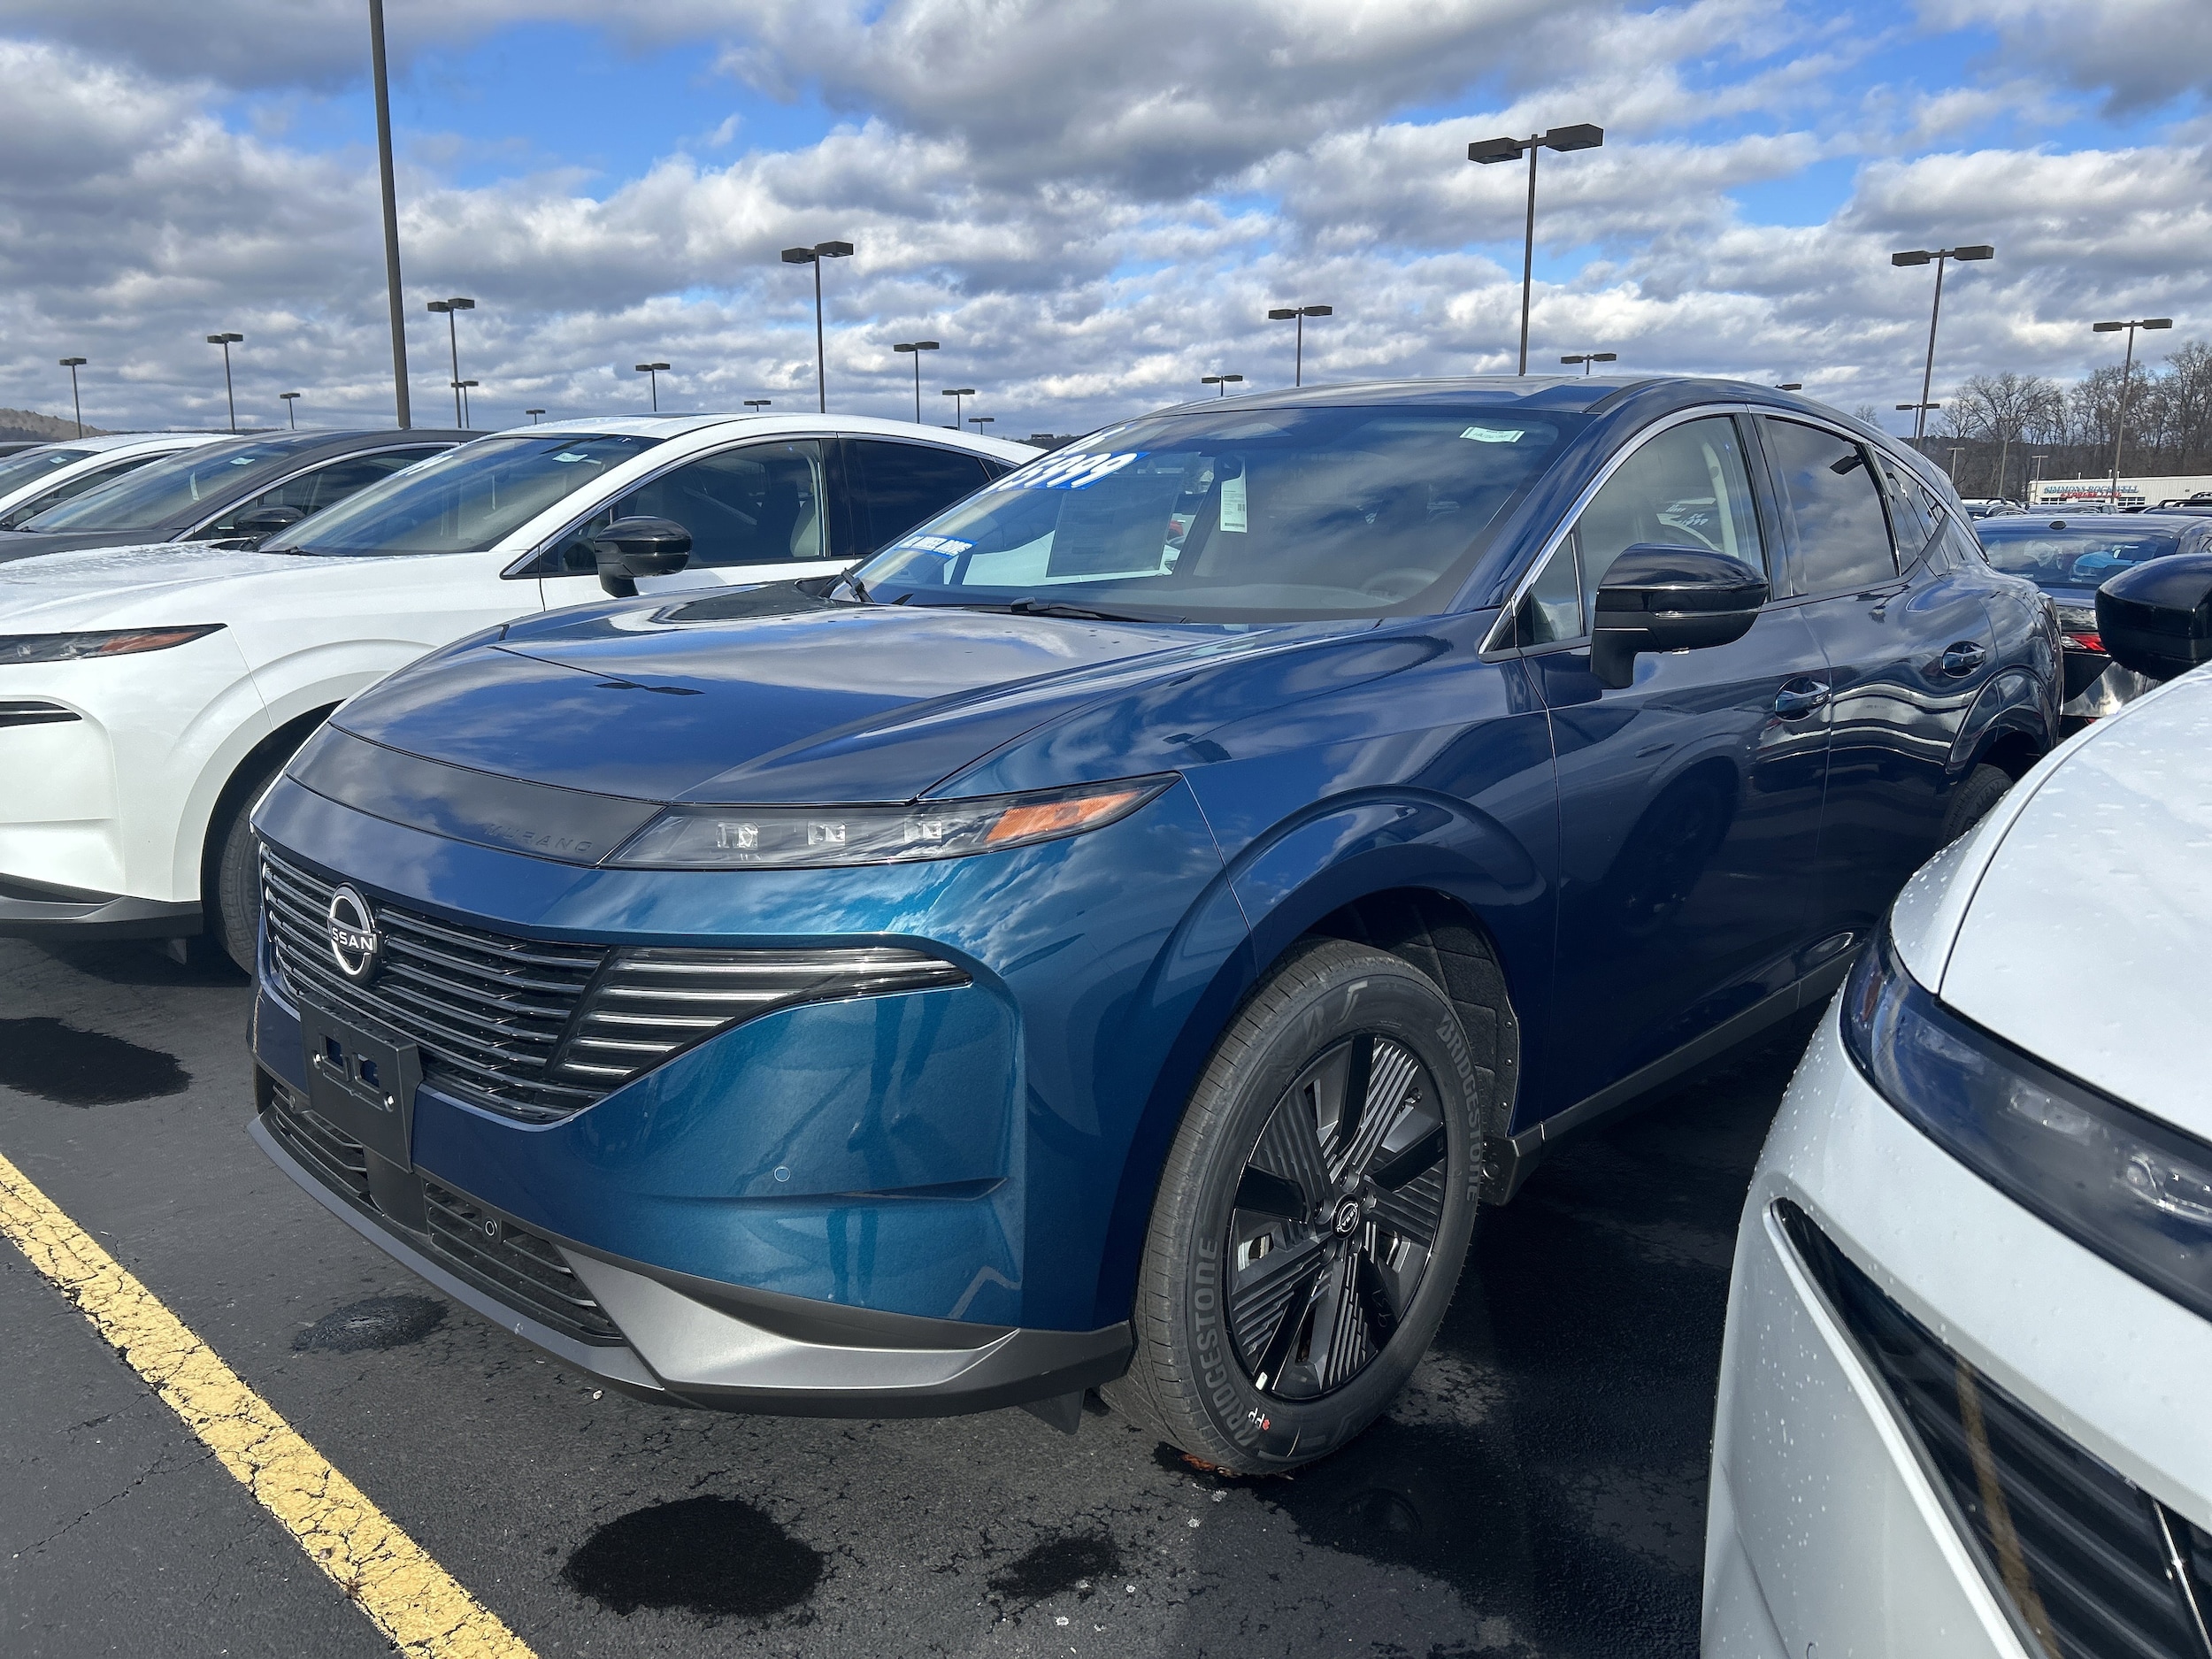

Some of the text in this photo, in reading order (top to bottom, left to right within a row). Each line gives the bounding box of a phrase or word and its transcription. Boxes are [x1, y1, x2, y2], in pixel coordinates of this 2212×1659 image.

[485, 824, 592, 851] MURANO
[332, 926, 373, 951] SSAN
[1436, 1011, 1481, 1202] BRIDGESTONE
[1194, 1237, 1260, 1448] BRIDGESTONE
